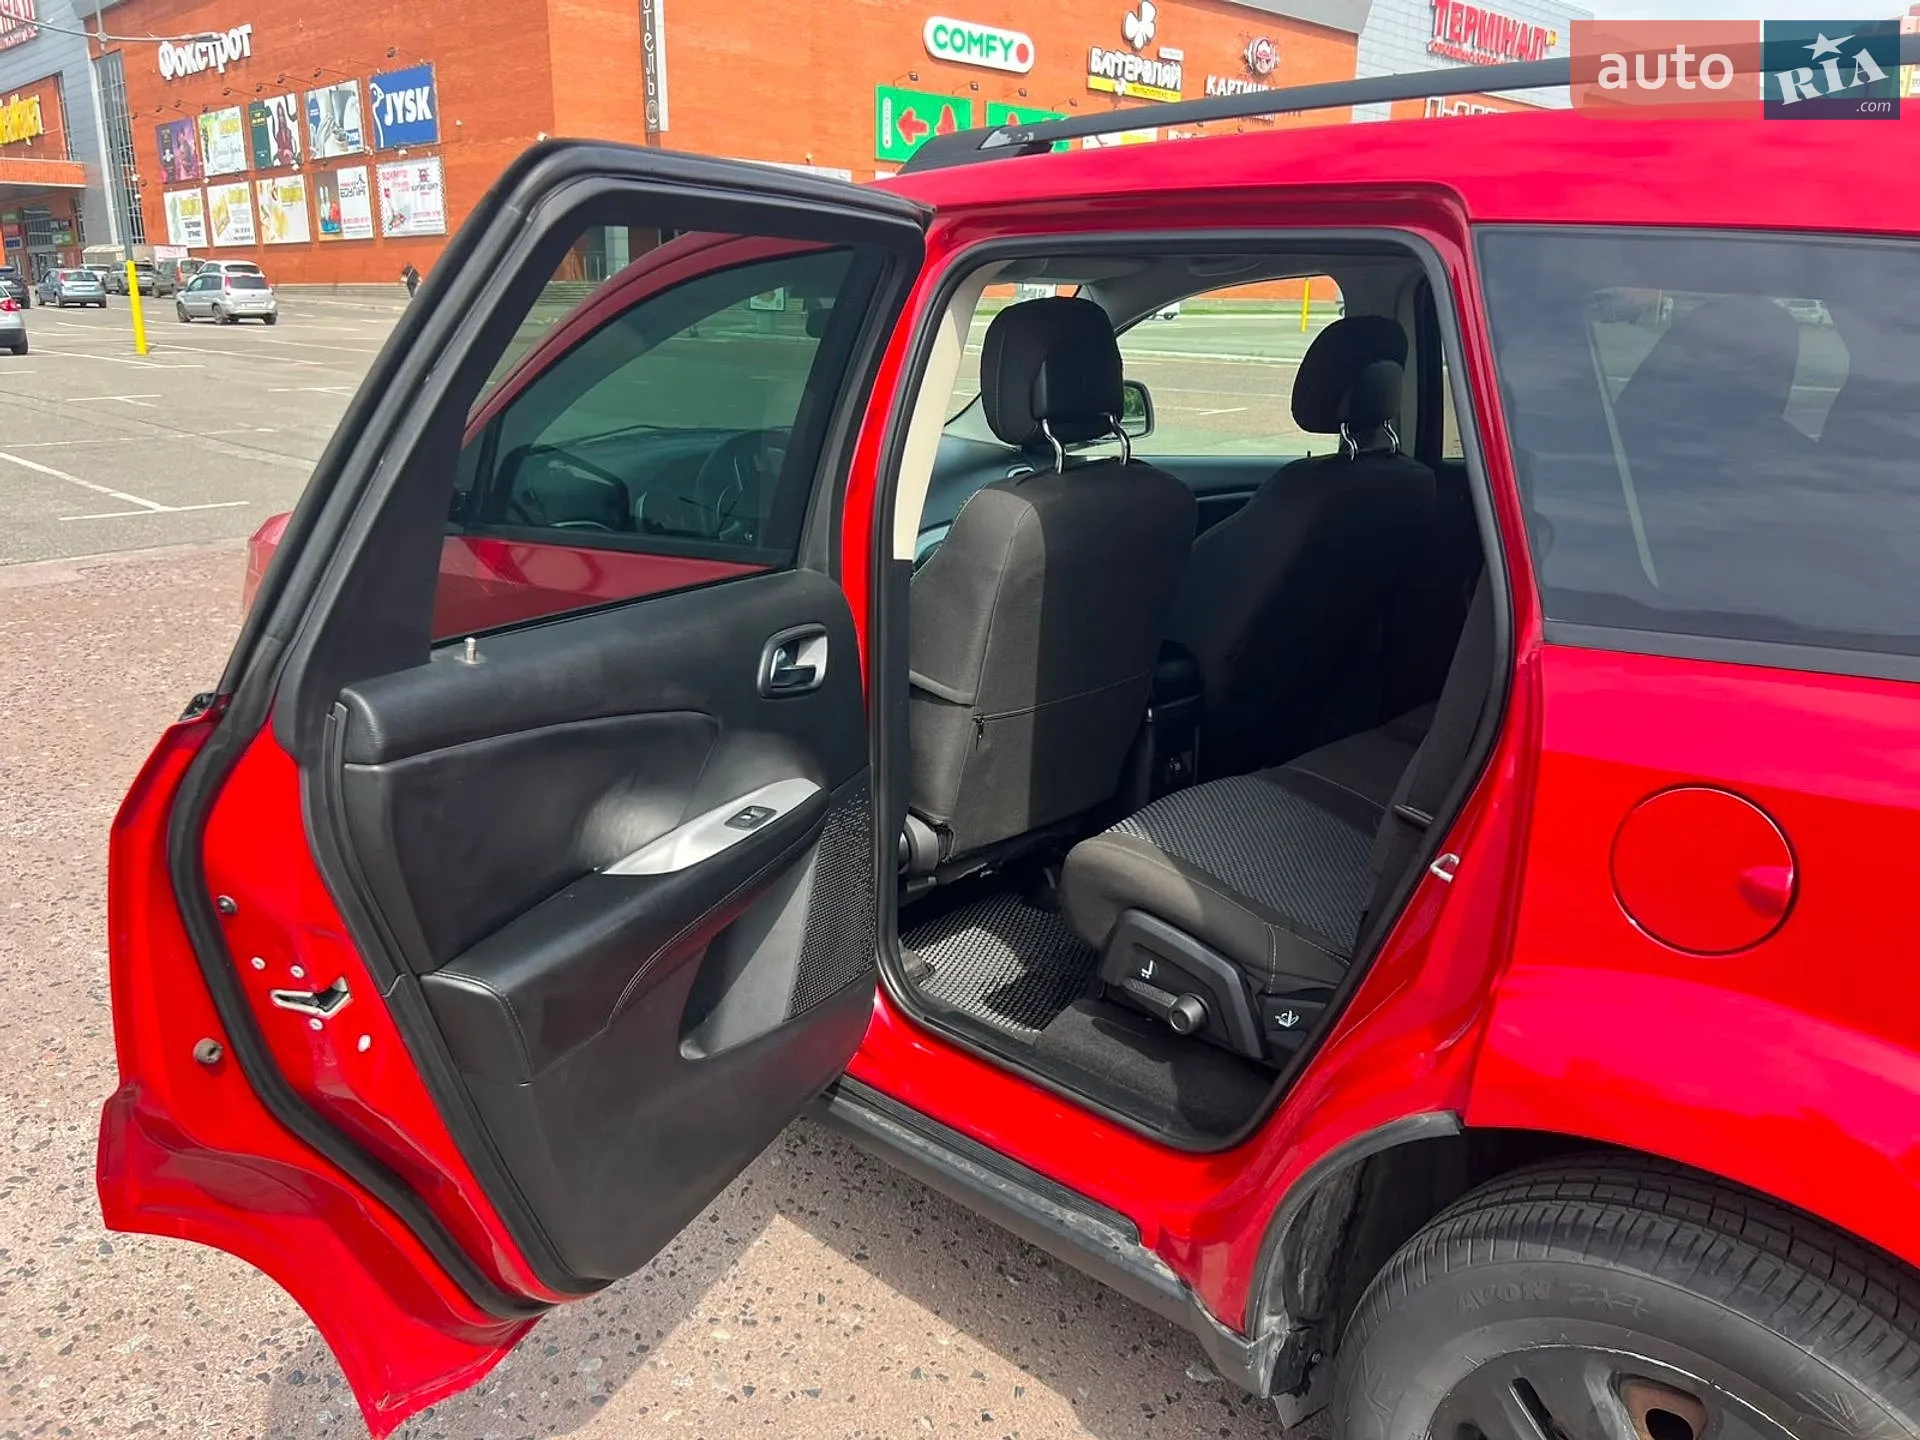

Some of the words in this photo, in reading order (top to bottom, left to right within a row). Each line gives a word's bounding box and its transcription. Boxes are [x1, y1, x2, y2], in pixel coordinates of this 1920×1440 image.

[933, 24, 1014, 63] COMFY
[1431, 0, 1547, 62] ТЕРМІНАЛ
[384, 86, 433, 127] JYSK
[1456, 1280, 1550, 1315] AVON
